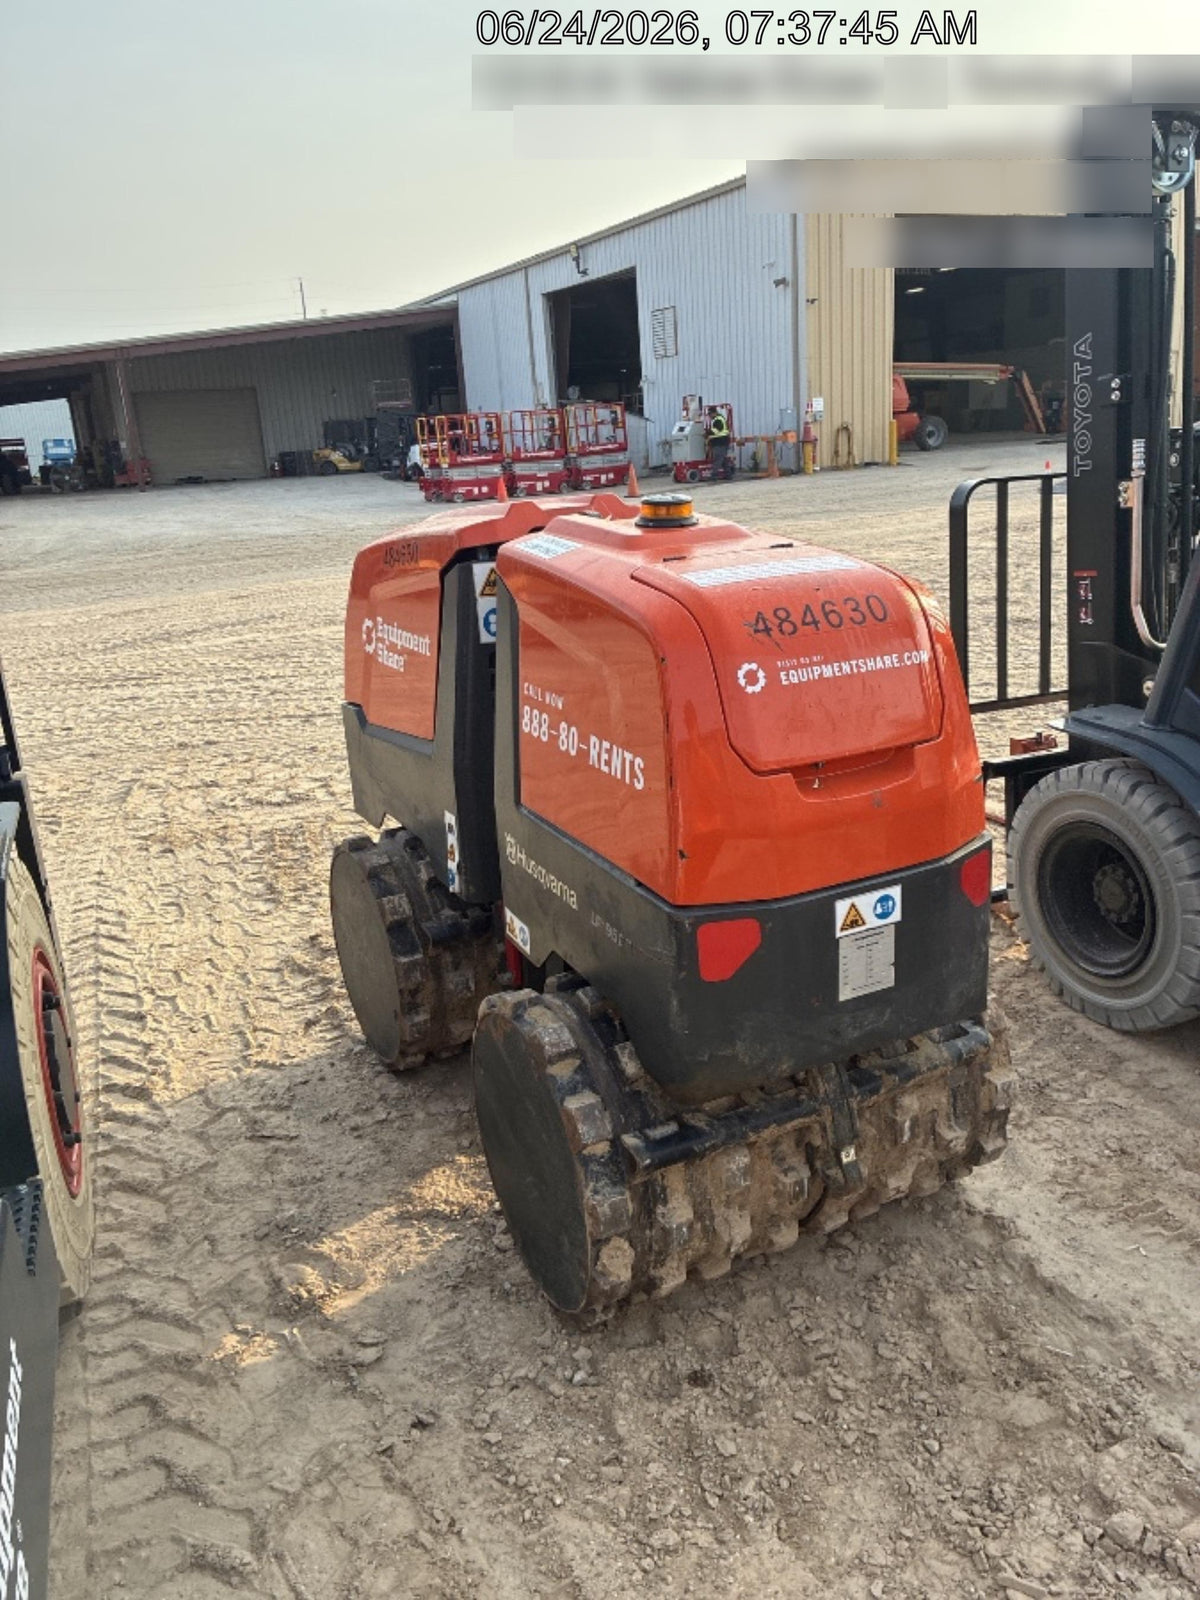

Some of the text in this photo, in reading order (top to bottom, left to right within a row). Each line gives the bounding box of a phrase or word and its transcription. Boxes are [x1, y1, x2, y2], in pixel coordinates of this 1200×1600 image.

[1073, 332, 1093, 477] TOYOTA
[376, 616, 431, 653] Equipment
[751, 593, 889, 638] 484630
[779, 650, 930, 686] EQUIPMENTSHARE.COM
[522, 705, 645, 791] 888-80-RENTS
